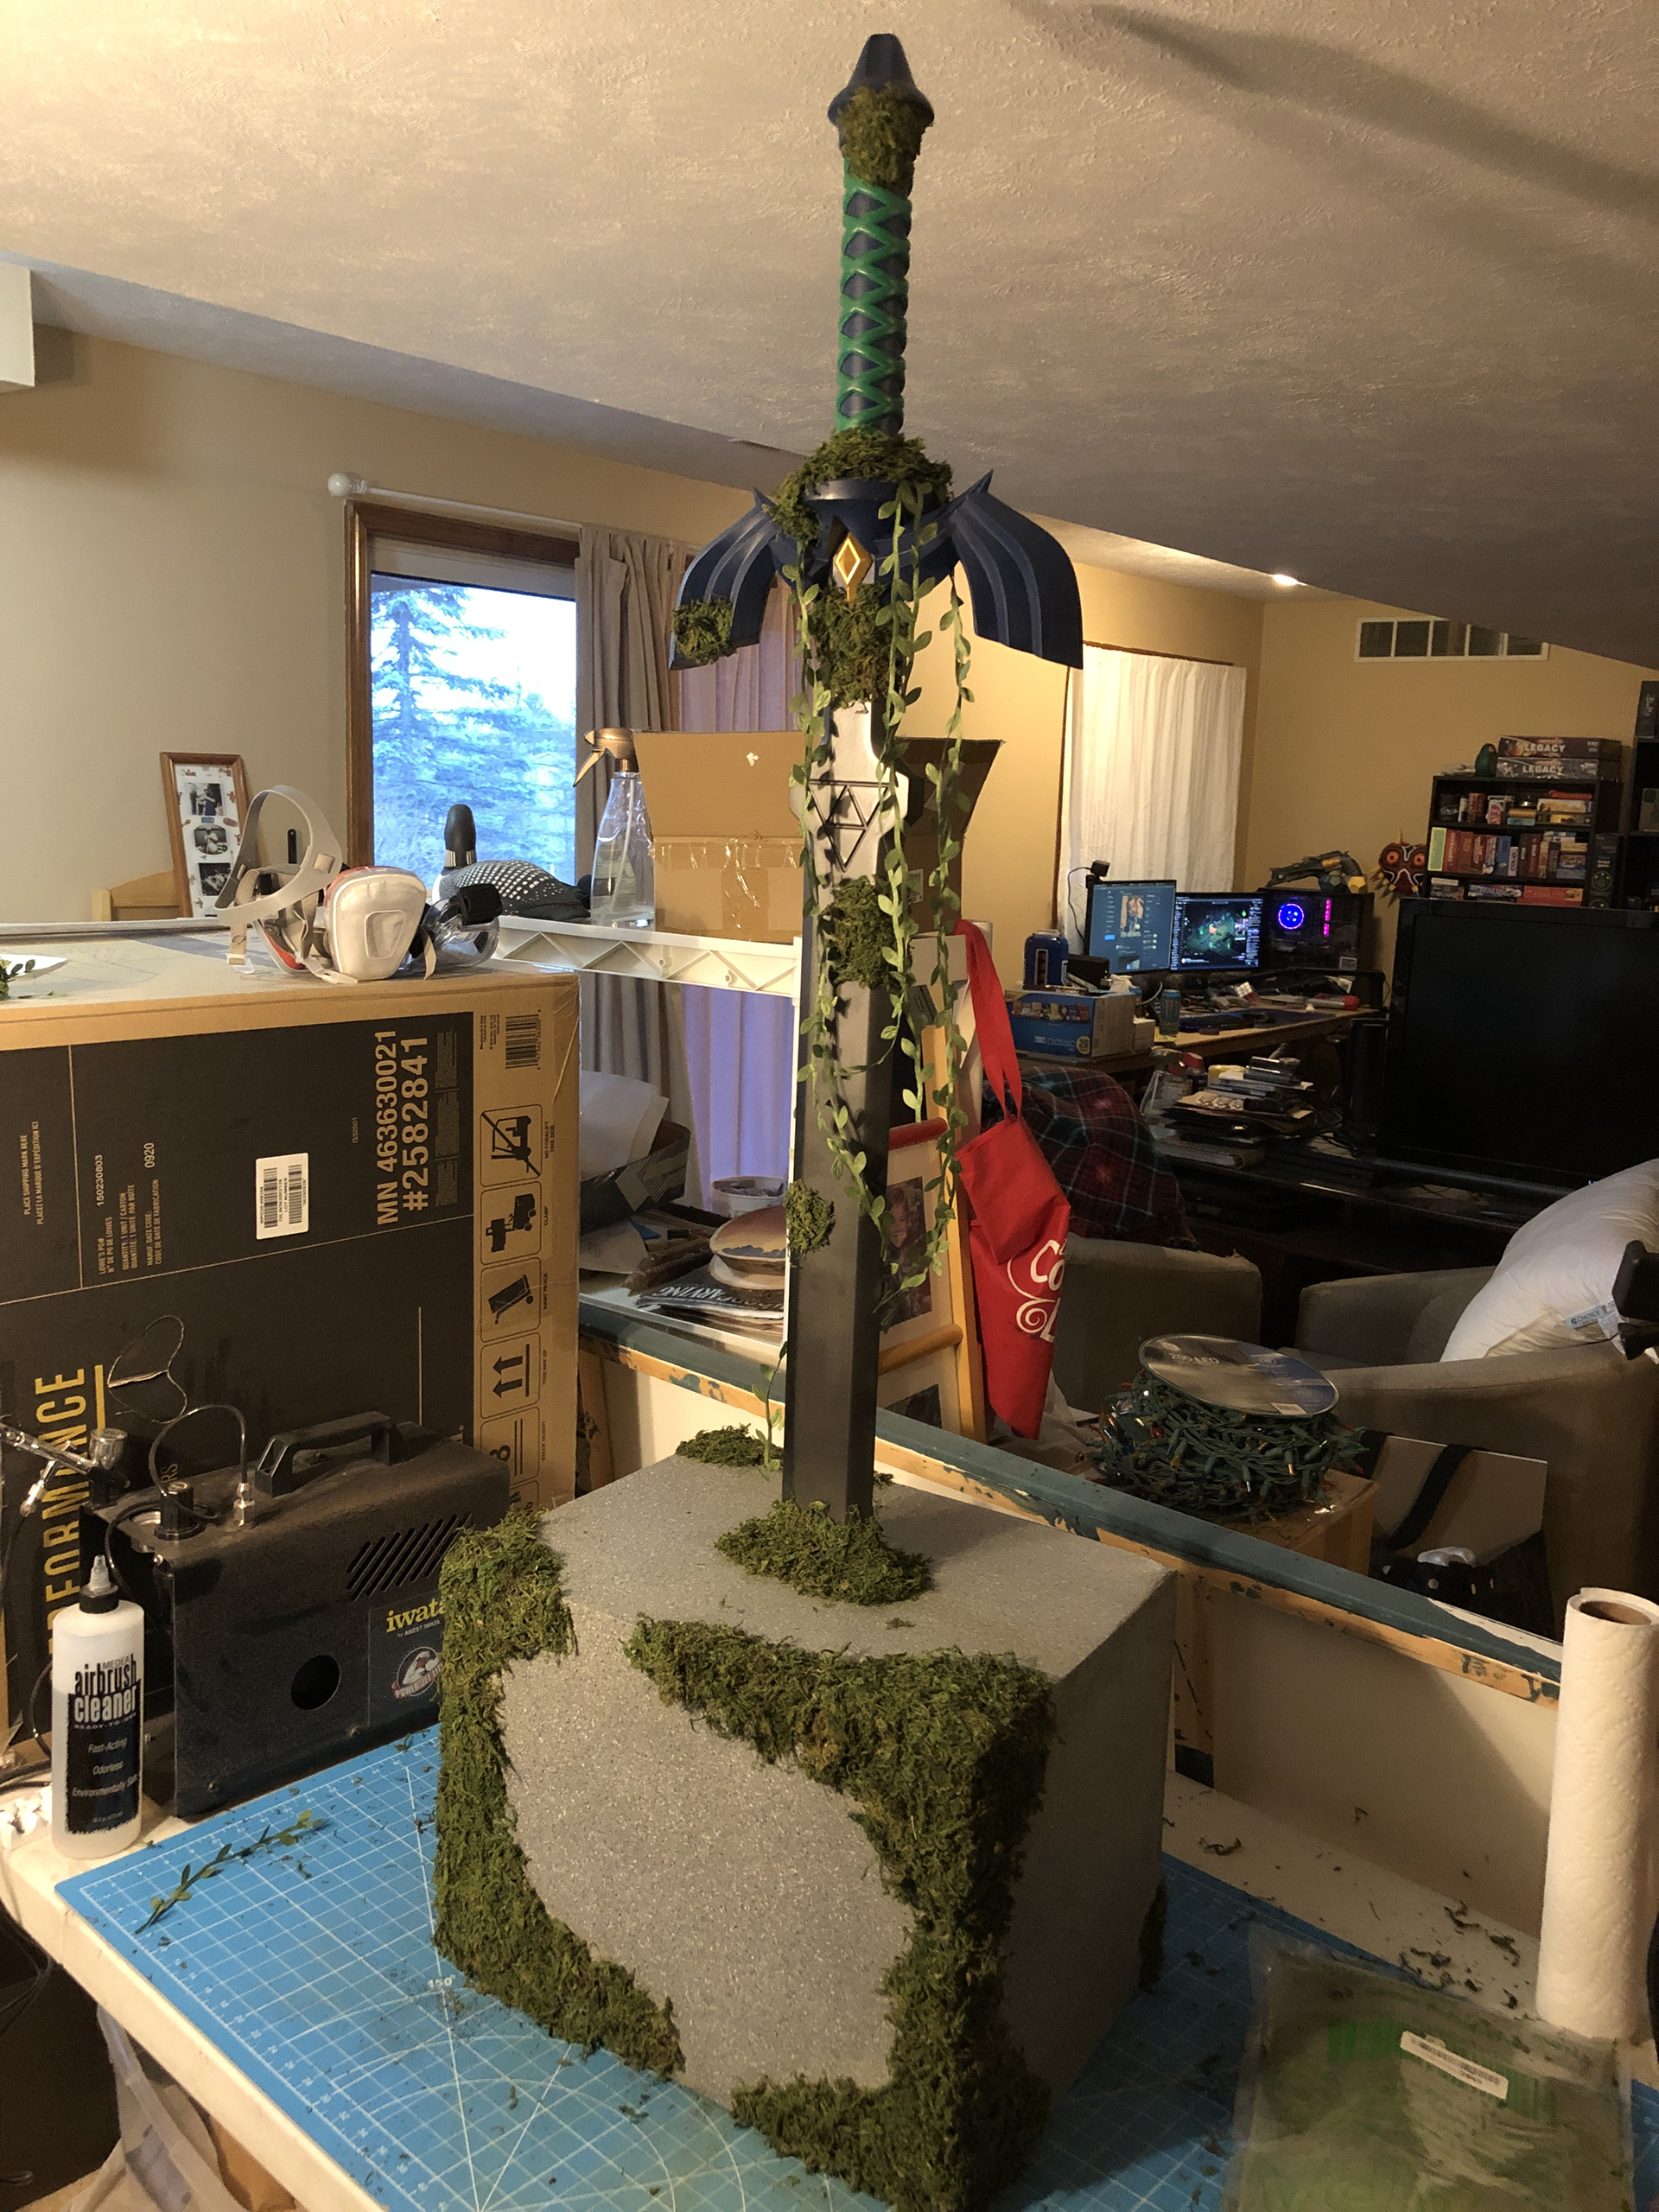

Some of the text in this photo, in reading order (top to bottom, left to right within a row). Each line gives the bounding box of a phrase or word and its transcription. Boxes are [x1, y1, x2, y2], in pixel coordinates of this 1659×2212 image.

[1524, 743, 1567, 752] LEGACY
[1046, 1036, 1076, 1048] classic
[374, 1031, 398, 1225] MN 463630021
[400, 1038, 429, 1211] #2582841
[143, 1142, 155, 1168] 0920
[19, 1135, 31, 1216] PLACE SHIPPING MARK HERE
[94, 1154, 105, 1206] 150230803
[118, 1192, 128, 1216] CARTON
[119, 1221, 128, 1235] UNIT
[386, 1598, 447, 1633] iwata
[74, 1653, 137, 1695] airbrush
[102, 1656, 130, 1669] MEDEA
[74, 1685, 137, 1723] cleaner
[88, 1738, 128, 1753] Fast-Acting
[92, 1761, 124, 1776] Odorless
[72, 1780, 126, 1797] Environmentally
